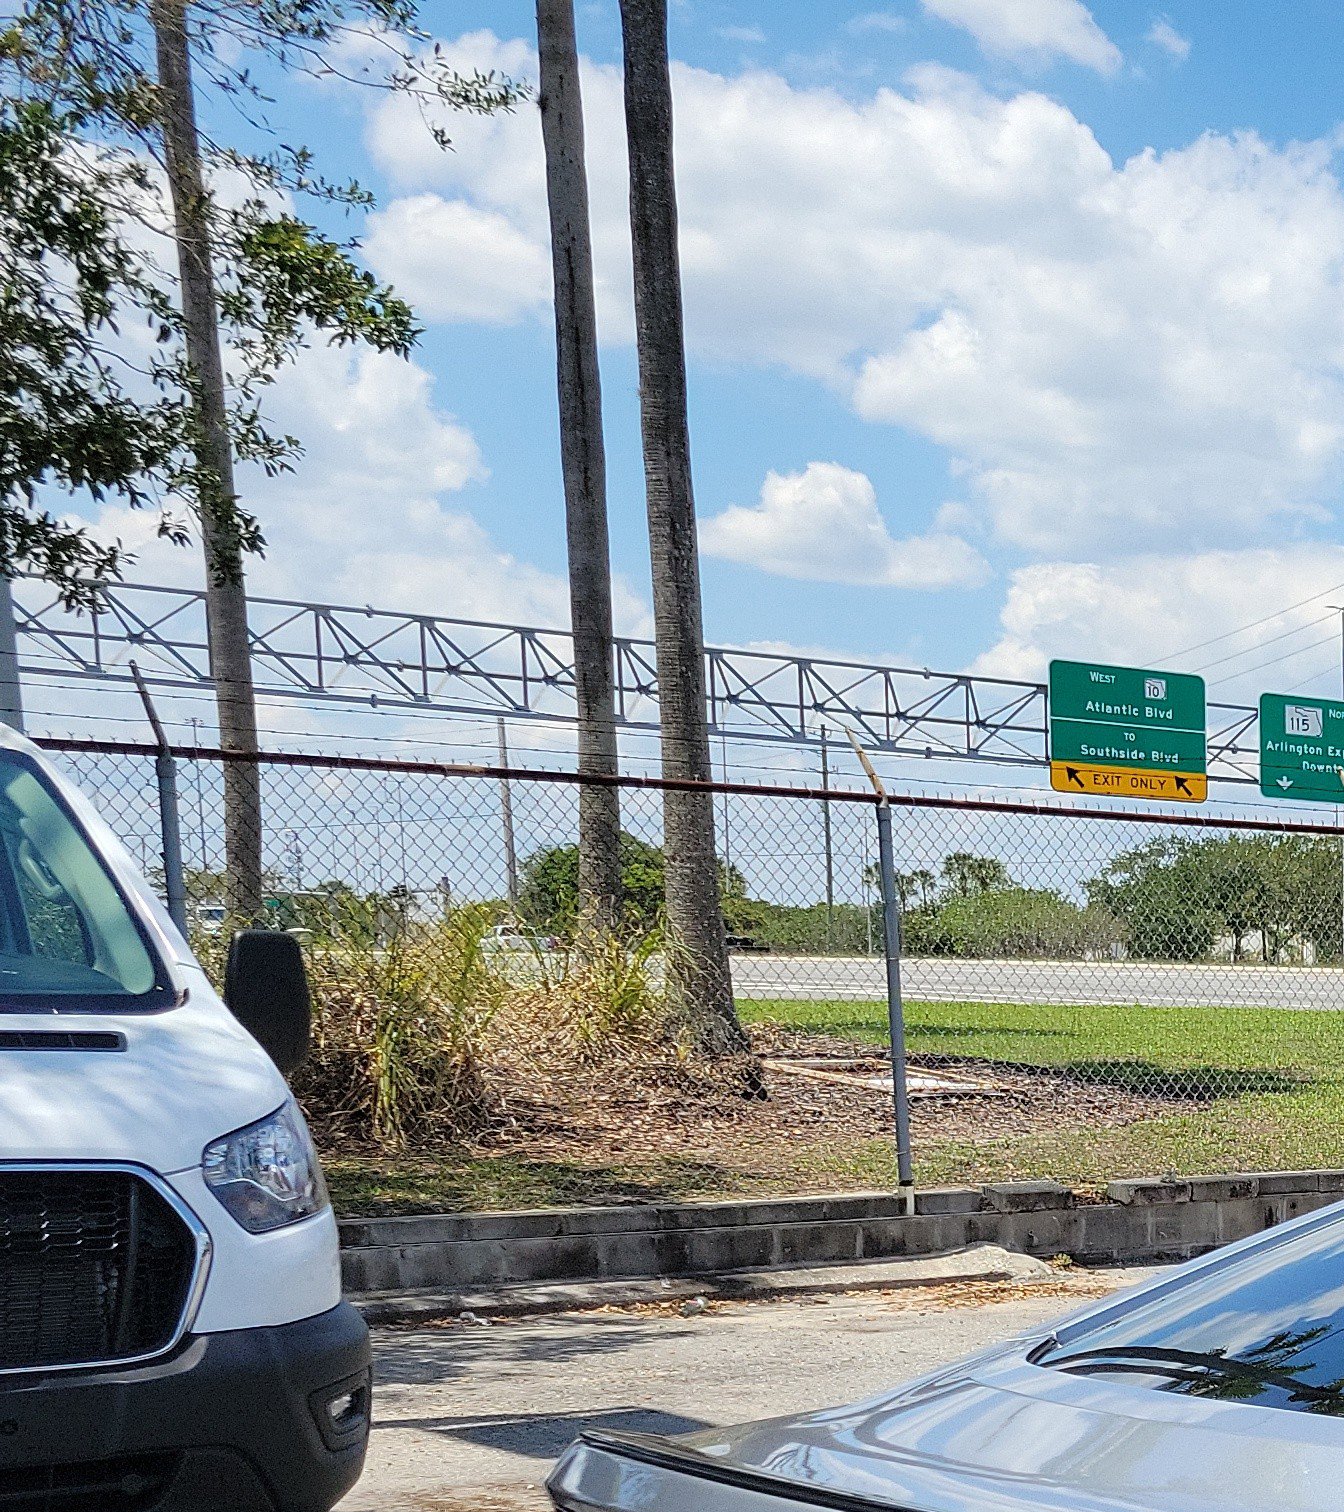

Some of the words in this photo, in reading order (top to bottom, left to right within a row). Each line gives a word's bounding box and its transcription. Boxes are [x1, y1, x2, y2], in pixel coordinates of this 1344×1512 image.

[1090, 671, 1116, 684] WEST
[1147, 686, 1160, 698] 10
[1086, 701, 1139, 716] Atlantic
[1145, 706, 1173, 720] Blvd
[1291, 717, 1310, 732] 115
[1124, 732, 1136, 742] TO
[1080, 744, 1145, 760] Southside
[1152, 751, 1179, 764] Blvd
[1266, 740, 1323, 756] Arlington
[1093, 773, 1122, 786] EXIT
[1130, 777, 1167, 790] ONLY
